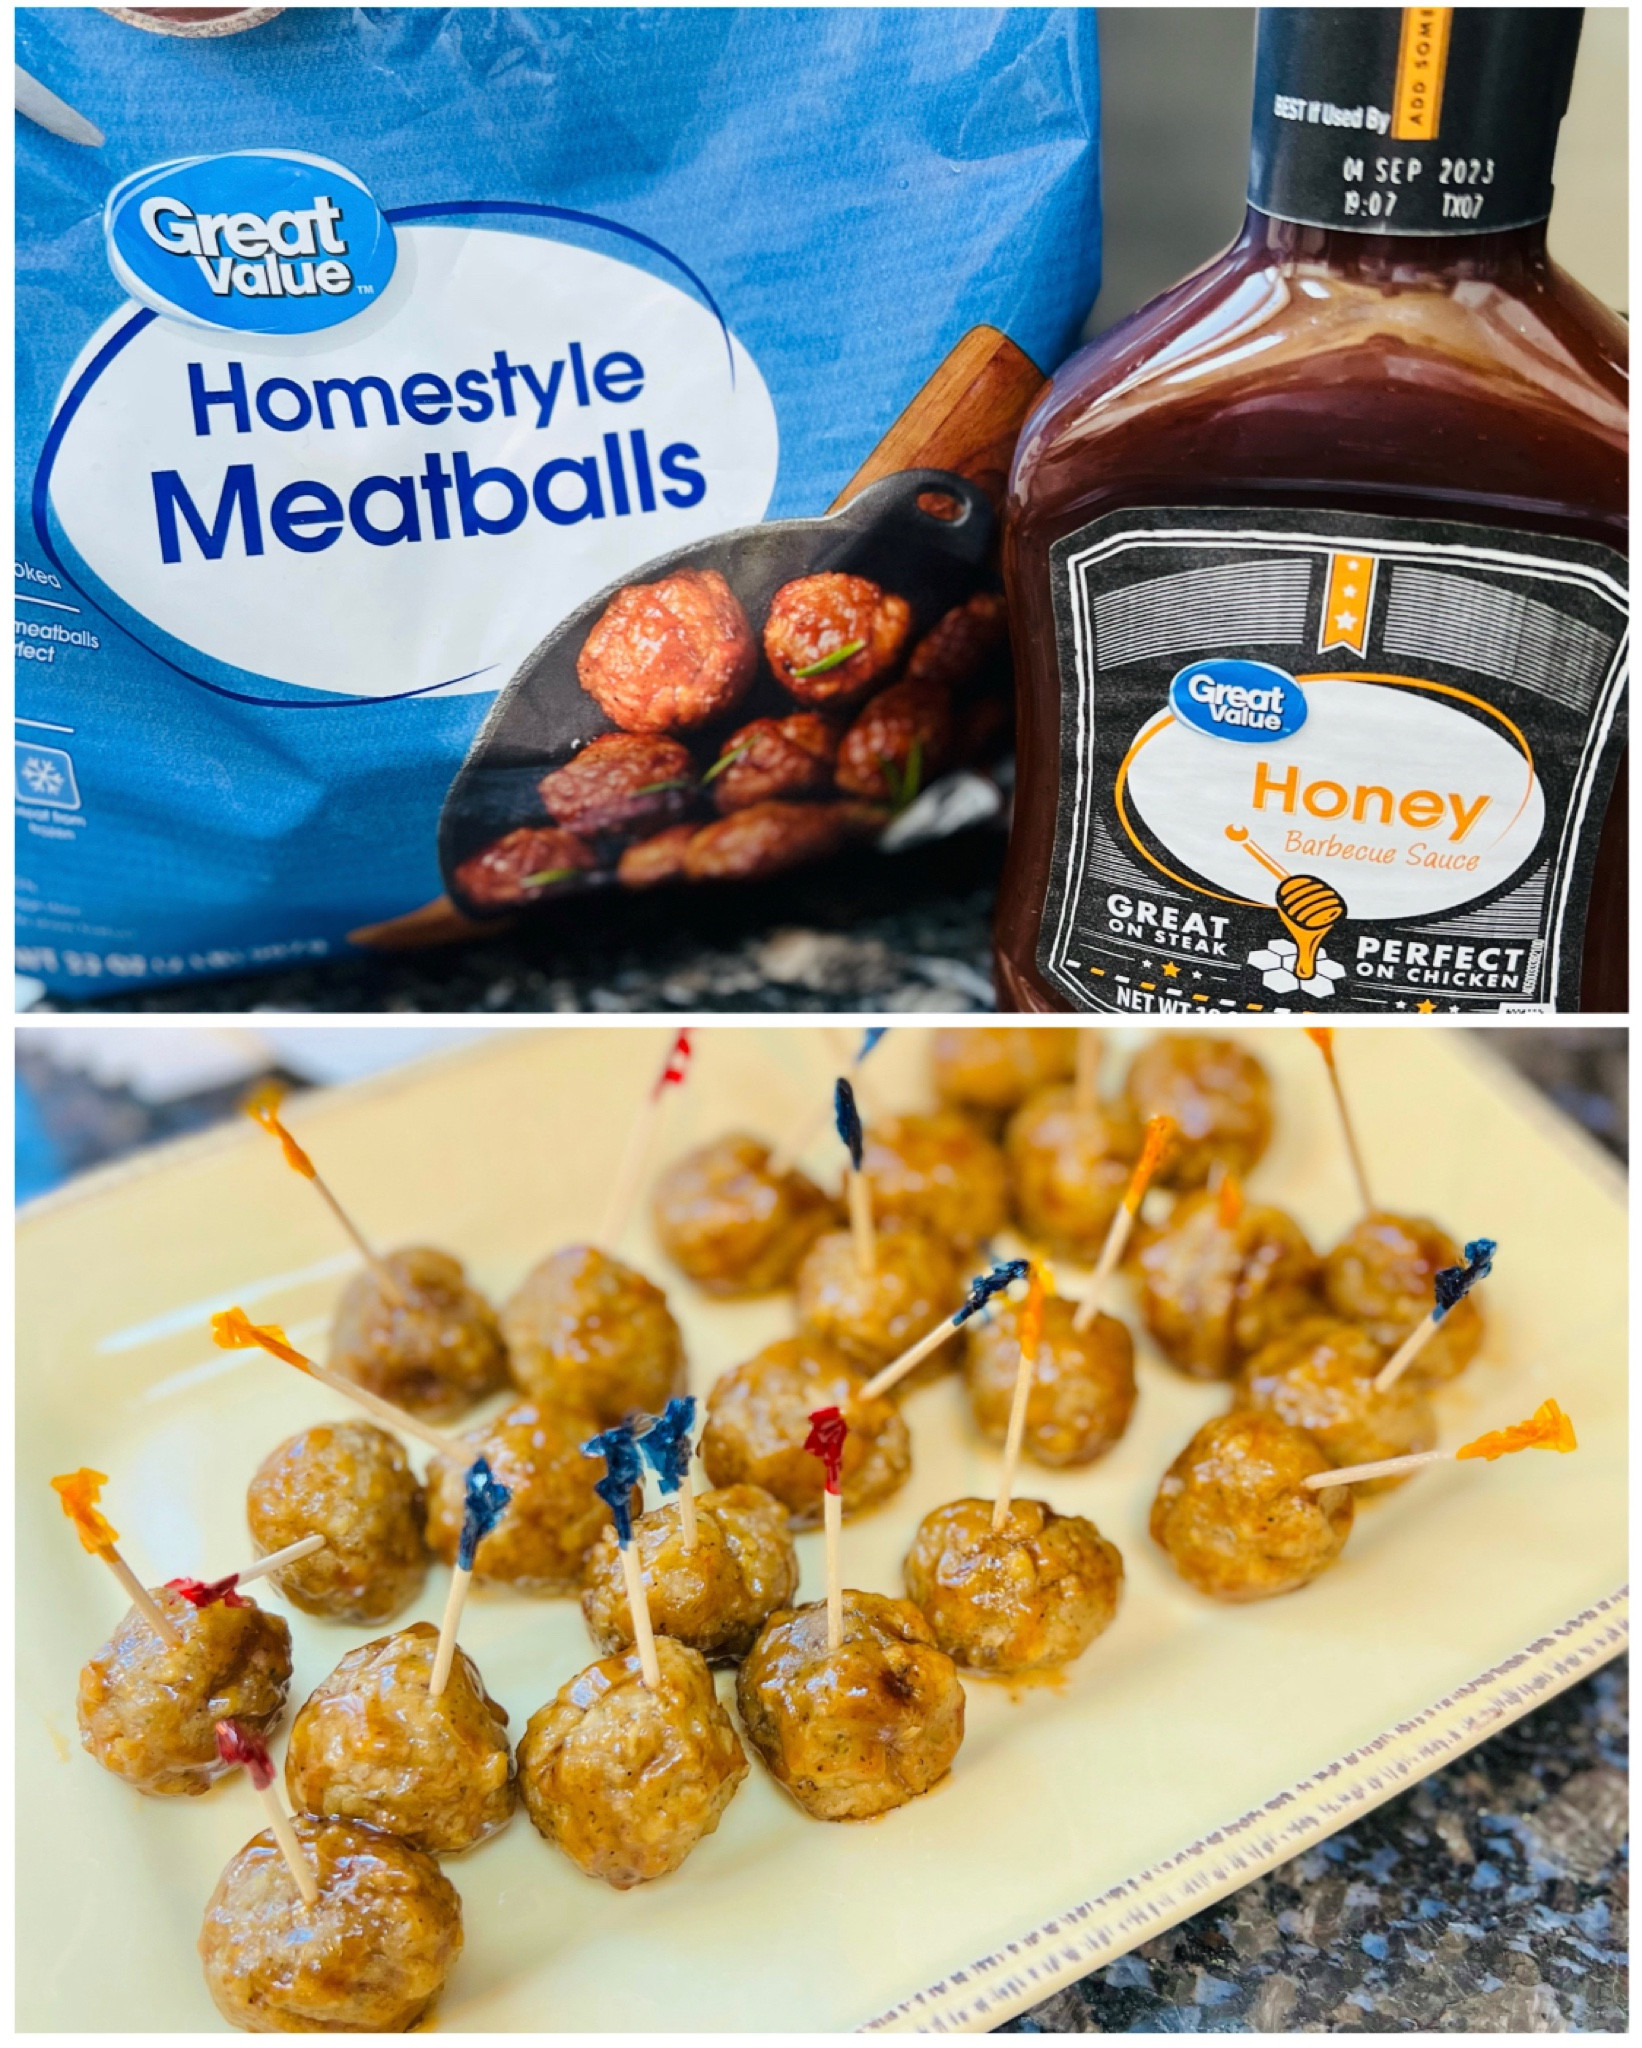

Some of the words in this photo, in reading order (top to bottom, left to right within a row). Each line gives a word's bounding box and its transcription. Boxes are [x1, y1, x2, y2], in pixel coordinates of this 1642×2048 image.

[1274, 94, 1308, 121] BEST
[1322, 102, 1364, 129] Used
[1365, 105, 1392, 135] By
[1409, 81, 1426, 127] ADD
[1375, 156, 1423, 185] SEP
[1439, 157, 1495, 185] 2023
[139, 196, 349, 257] Great
[199, 254, 353, 298] Value
[187, 342, 646, 436] Homestyle
[151, 429, 707, 565] Meatballs
[1188, 674, 1285, 714] Great
[1209, 701, 1282, 730] Value
[1252, 761, 1492, 843] Honey
[1284, 829, 1397, 865] Barbecue
[1406, 842, 1480, 871] Sauce
[1107, 893, 1230, 939] GREAT
[1108, 918, 1142, 938] ON
[1154, 930, 1227, 956] STEAK
[1356, 935, 1525, 972] PERFECT
[1356, 962, 1394, 980] ON
[1406, 968, 1519, 988] CHICKEN
[1117, 985, 1154, 1013] NET
[1158, 996, 1192, 1014] WT
